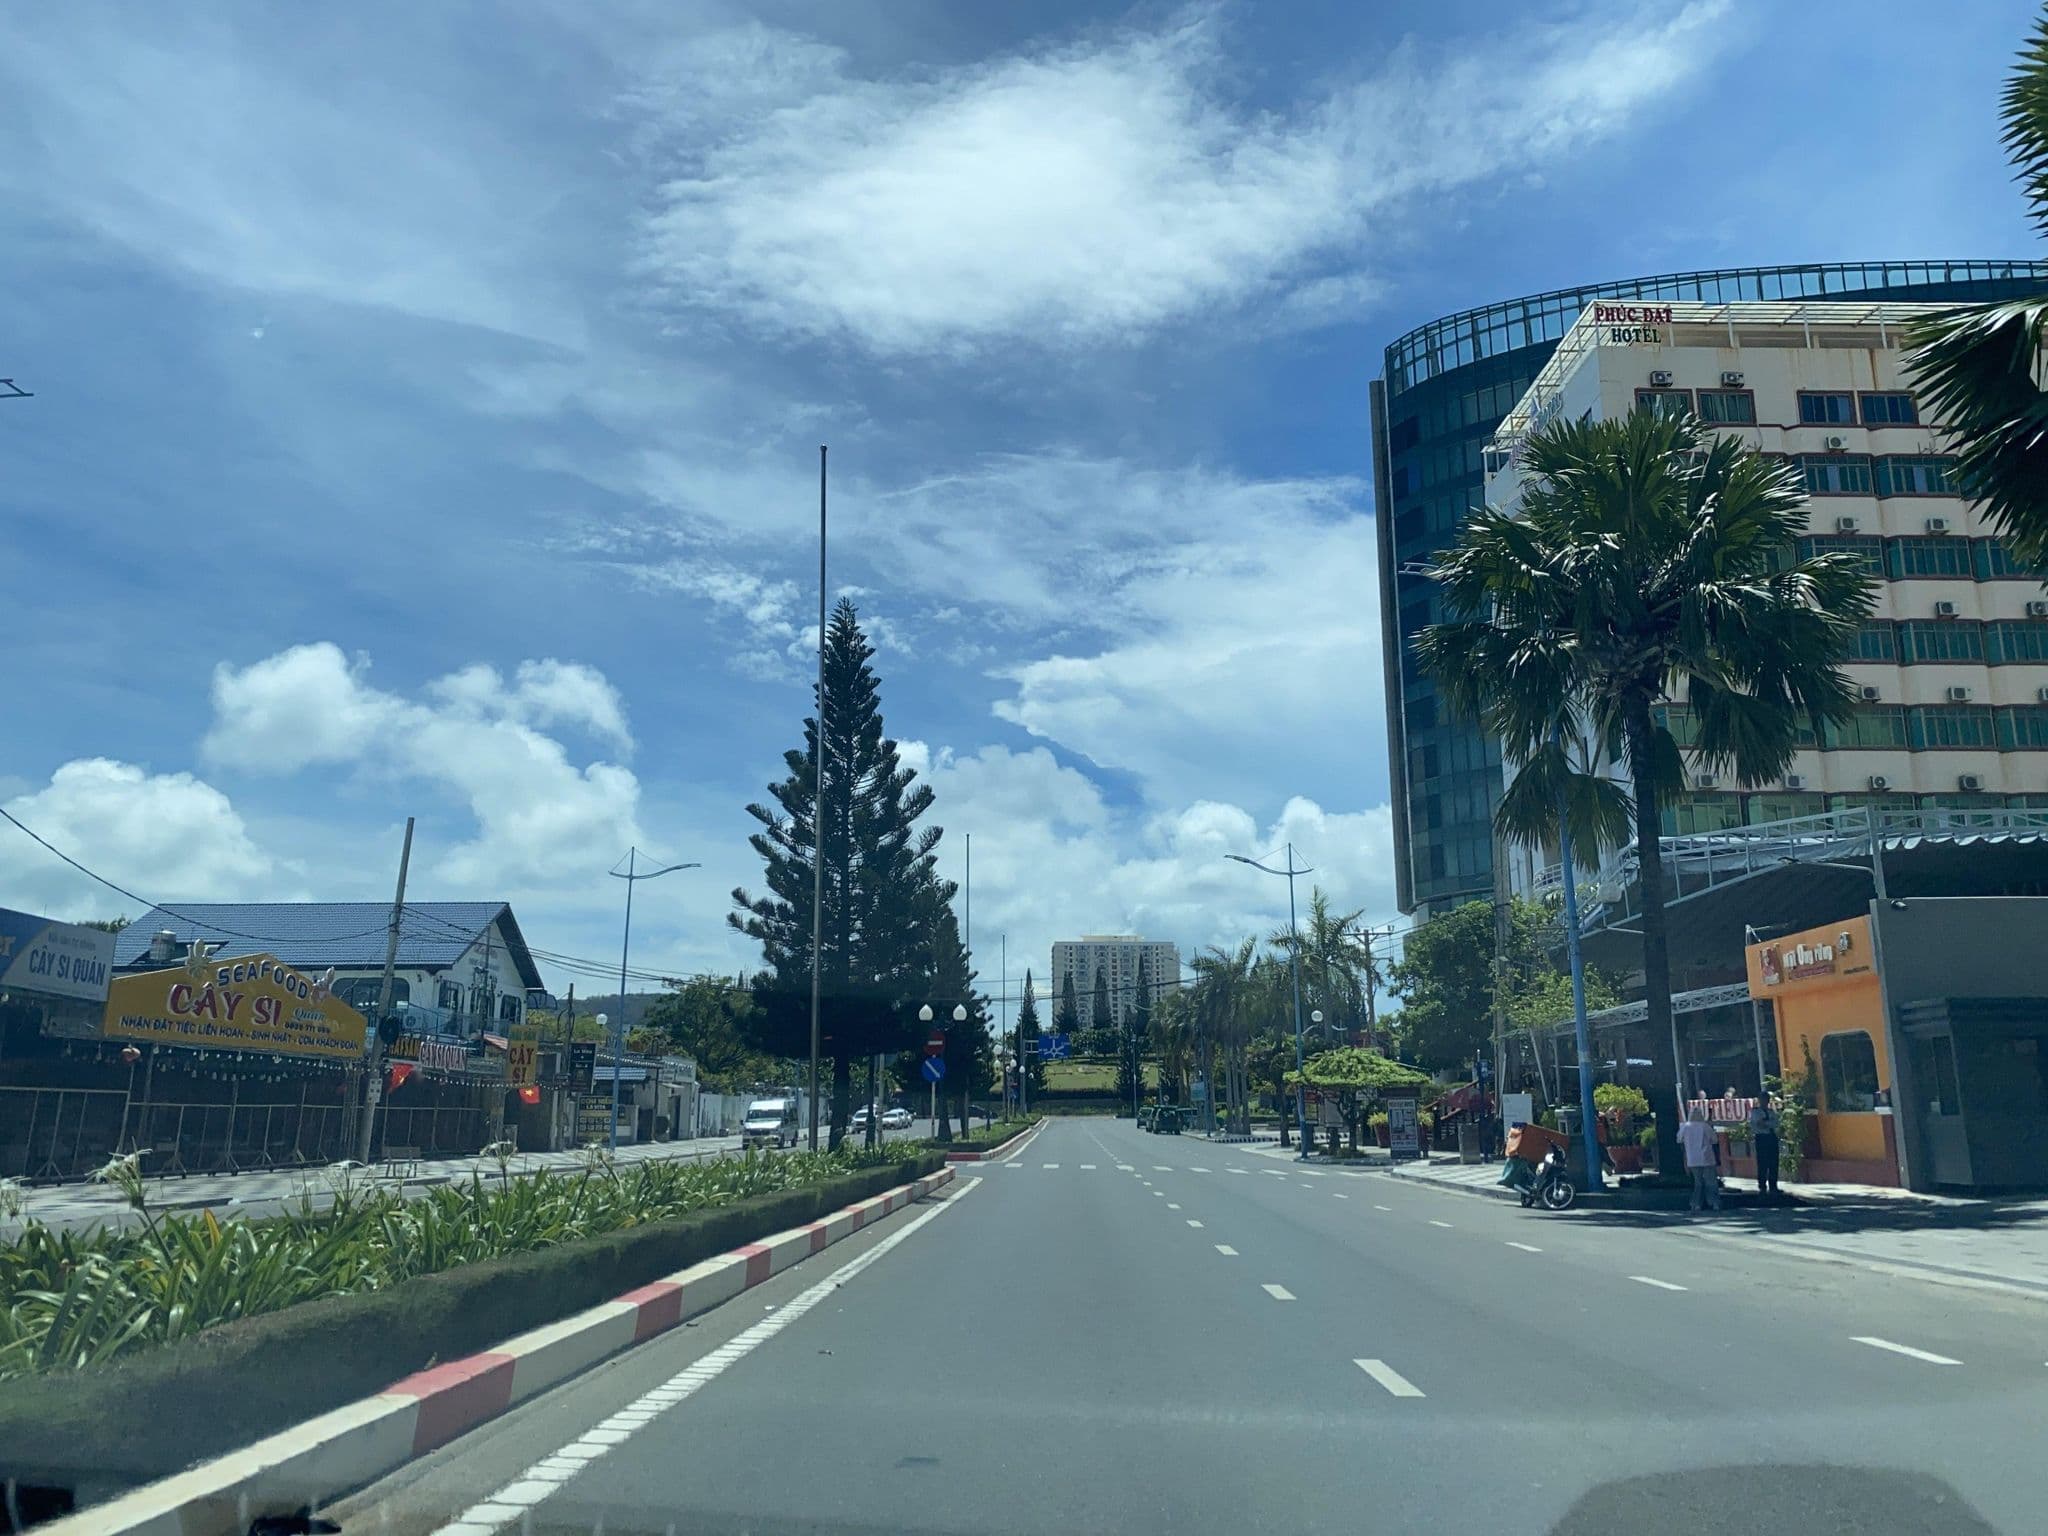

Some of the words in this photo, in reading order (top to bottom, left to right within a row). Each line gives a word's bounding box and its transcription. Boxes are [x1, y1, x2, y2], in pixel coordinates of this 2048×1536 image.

[1596, 304, 1636, 322] PHÚC
[1611, 328, 1661, 343] HOTEL
[29, 945, 55, 976] CÂY
[57, 955, 70, 979] SI
[72, 956, 106, 986] QUÁN
[217, 960, 308, 999] SEAFOOD
[168, 982, 244, 1020] CÂY
[252, 996, 282, 1025] SI
[120, 1016, 150, 1031] NHẬN
[510, 1045, 534, 1065] CÂY
